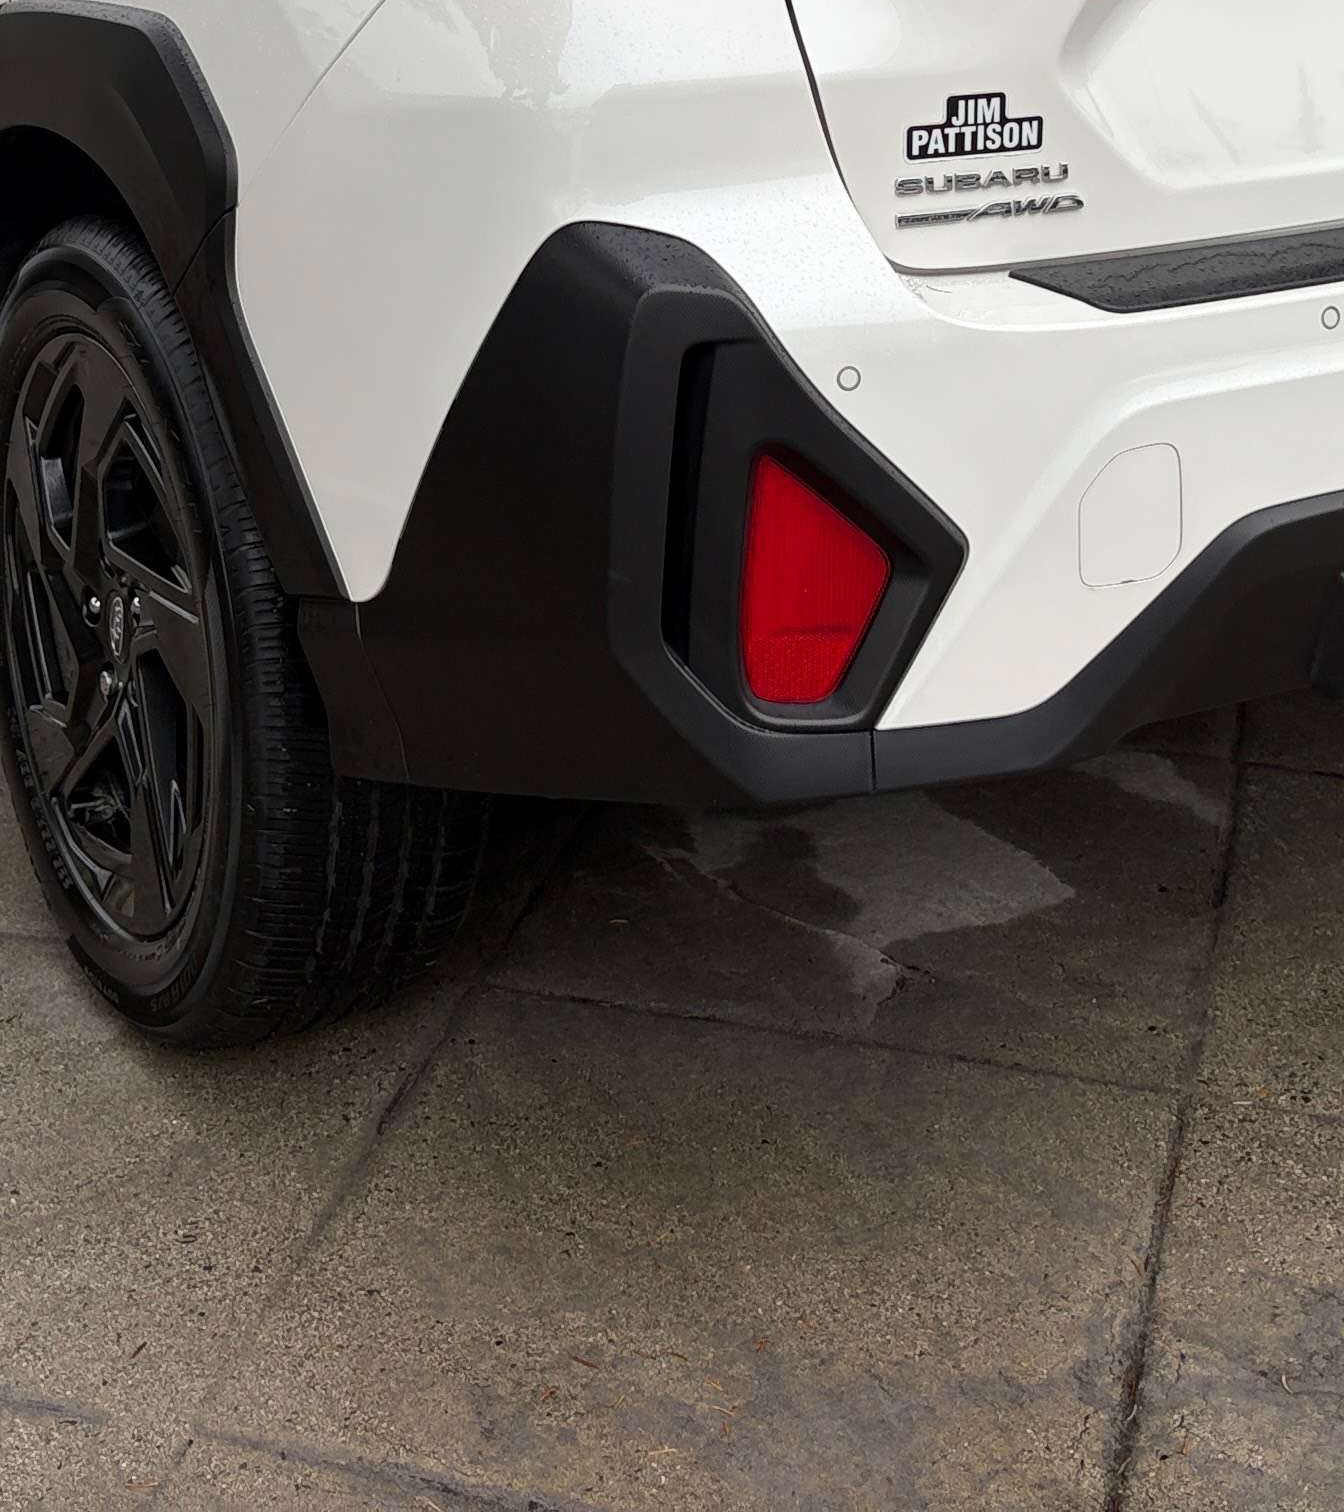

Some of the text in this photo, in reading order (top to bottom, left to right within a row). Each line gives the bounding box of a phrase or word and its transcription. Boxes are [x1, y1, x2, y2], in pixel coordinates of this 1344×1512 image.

[951, 96, 1001, 127] JIM
[911, 120, 1040, 156] PATTISON
[894, 162, 1069, 198] SUBARU
[966, 192, 1085, 222] AWD
